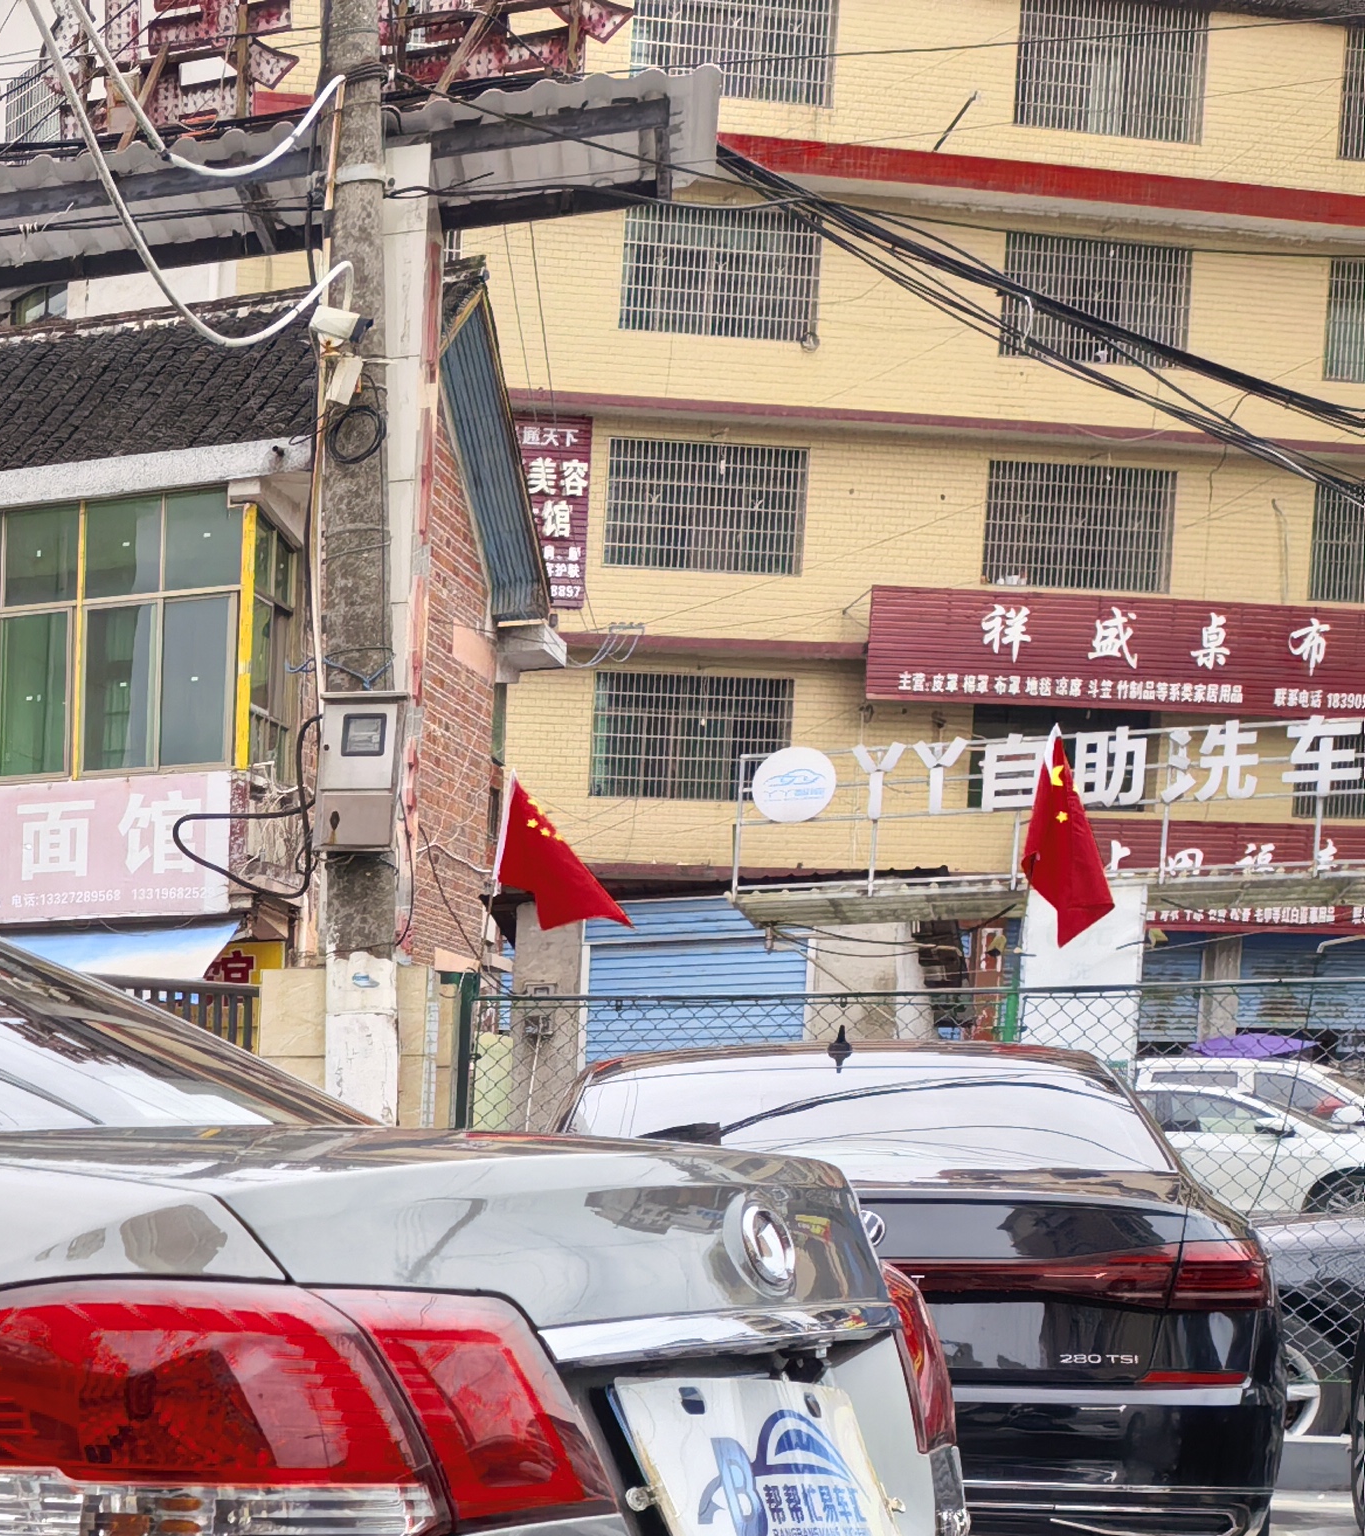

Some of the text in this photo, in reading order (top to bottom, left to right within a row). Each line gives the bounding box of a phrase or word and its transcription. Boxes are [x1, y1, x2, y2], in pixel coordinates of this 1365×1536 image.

[515, 426, 579, 448] 通天下
[521, 457, 589, 496] 美容
[533, 500, 573, 538] 馆
[981, 604, 1331, 678] 祥盛桌布
[1273, 687, 1323, 709] 联系电话
[1326, 692, 1365, 710] 18390
[1059, 1353, 1139, 1364] 280 TSI
[763, 1482, 867, 1525] 帮帮忙易车汇
